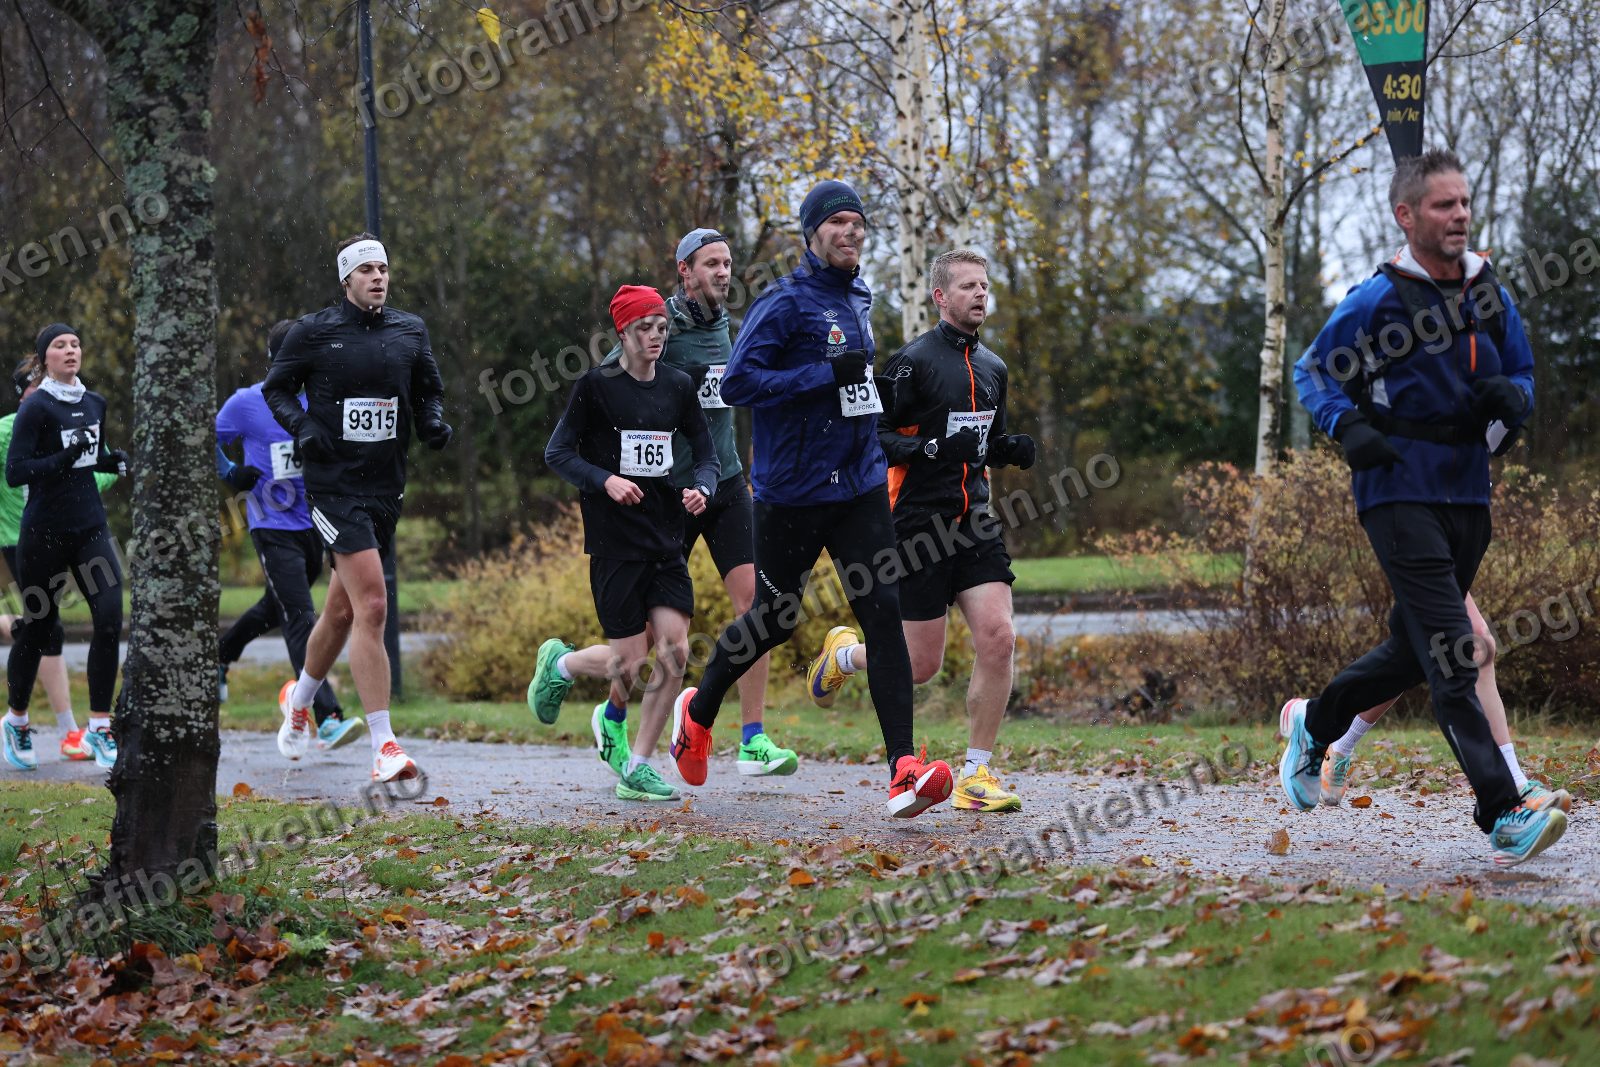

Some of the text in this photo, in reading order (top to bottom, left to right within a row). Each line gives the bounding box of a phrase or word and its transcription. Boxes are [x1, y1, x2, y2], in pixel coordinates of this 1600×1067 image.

[1383, 74, 1421, 99] 4:30
[845, 377, 878, 403] 951
[349, 409, 395, 430] 9315
[633, 443, 664, 466] 165
